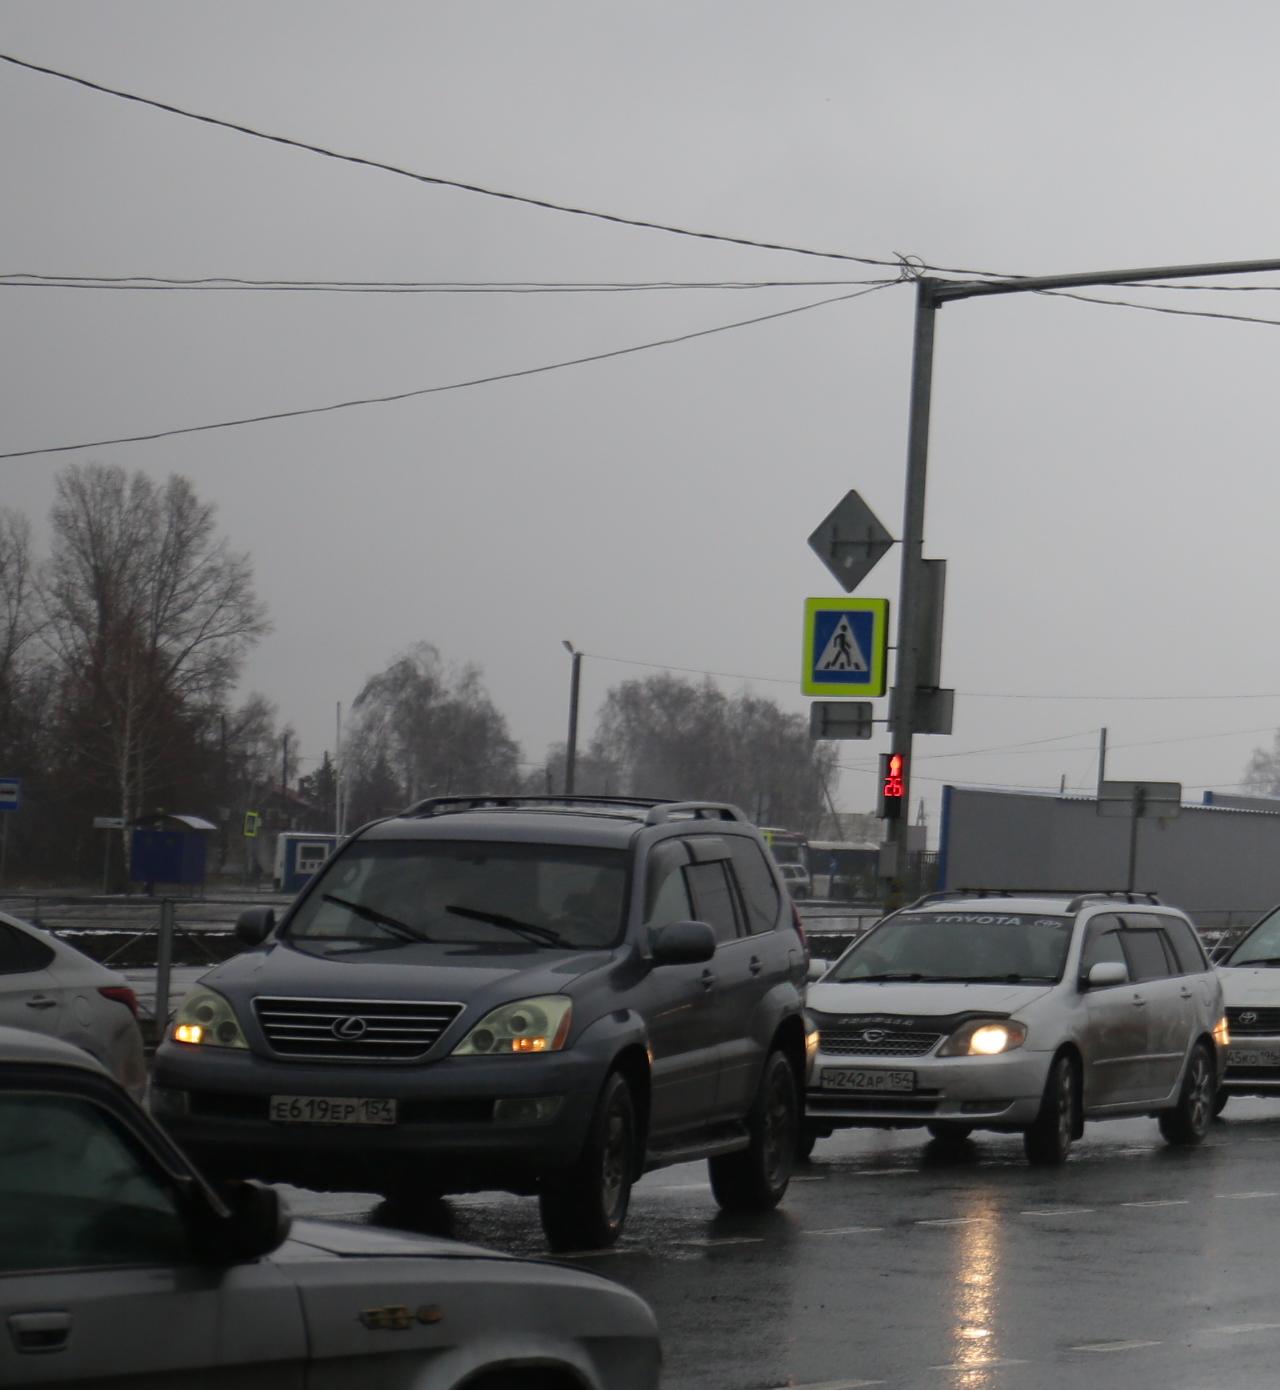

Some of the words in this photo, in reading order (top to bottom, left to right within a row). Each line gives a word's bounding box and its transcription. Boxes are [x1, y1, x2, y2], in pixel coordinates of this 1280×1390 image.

[884, 778, 902, 797] 26
[934, 915, 1021, 926] TOYOTA
[276, 1099, 355, 1120] Е619ЕР
[361, 1100, 392, 1116] 154
